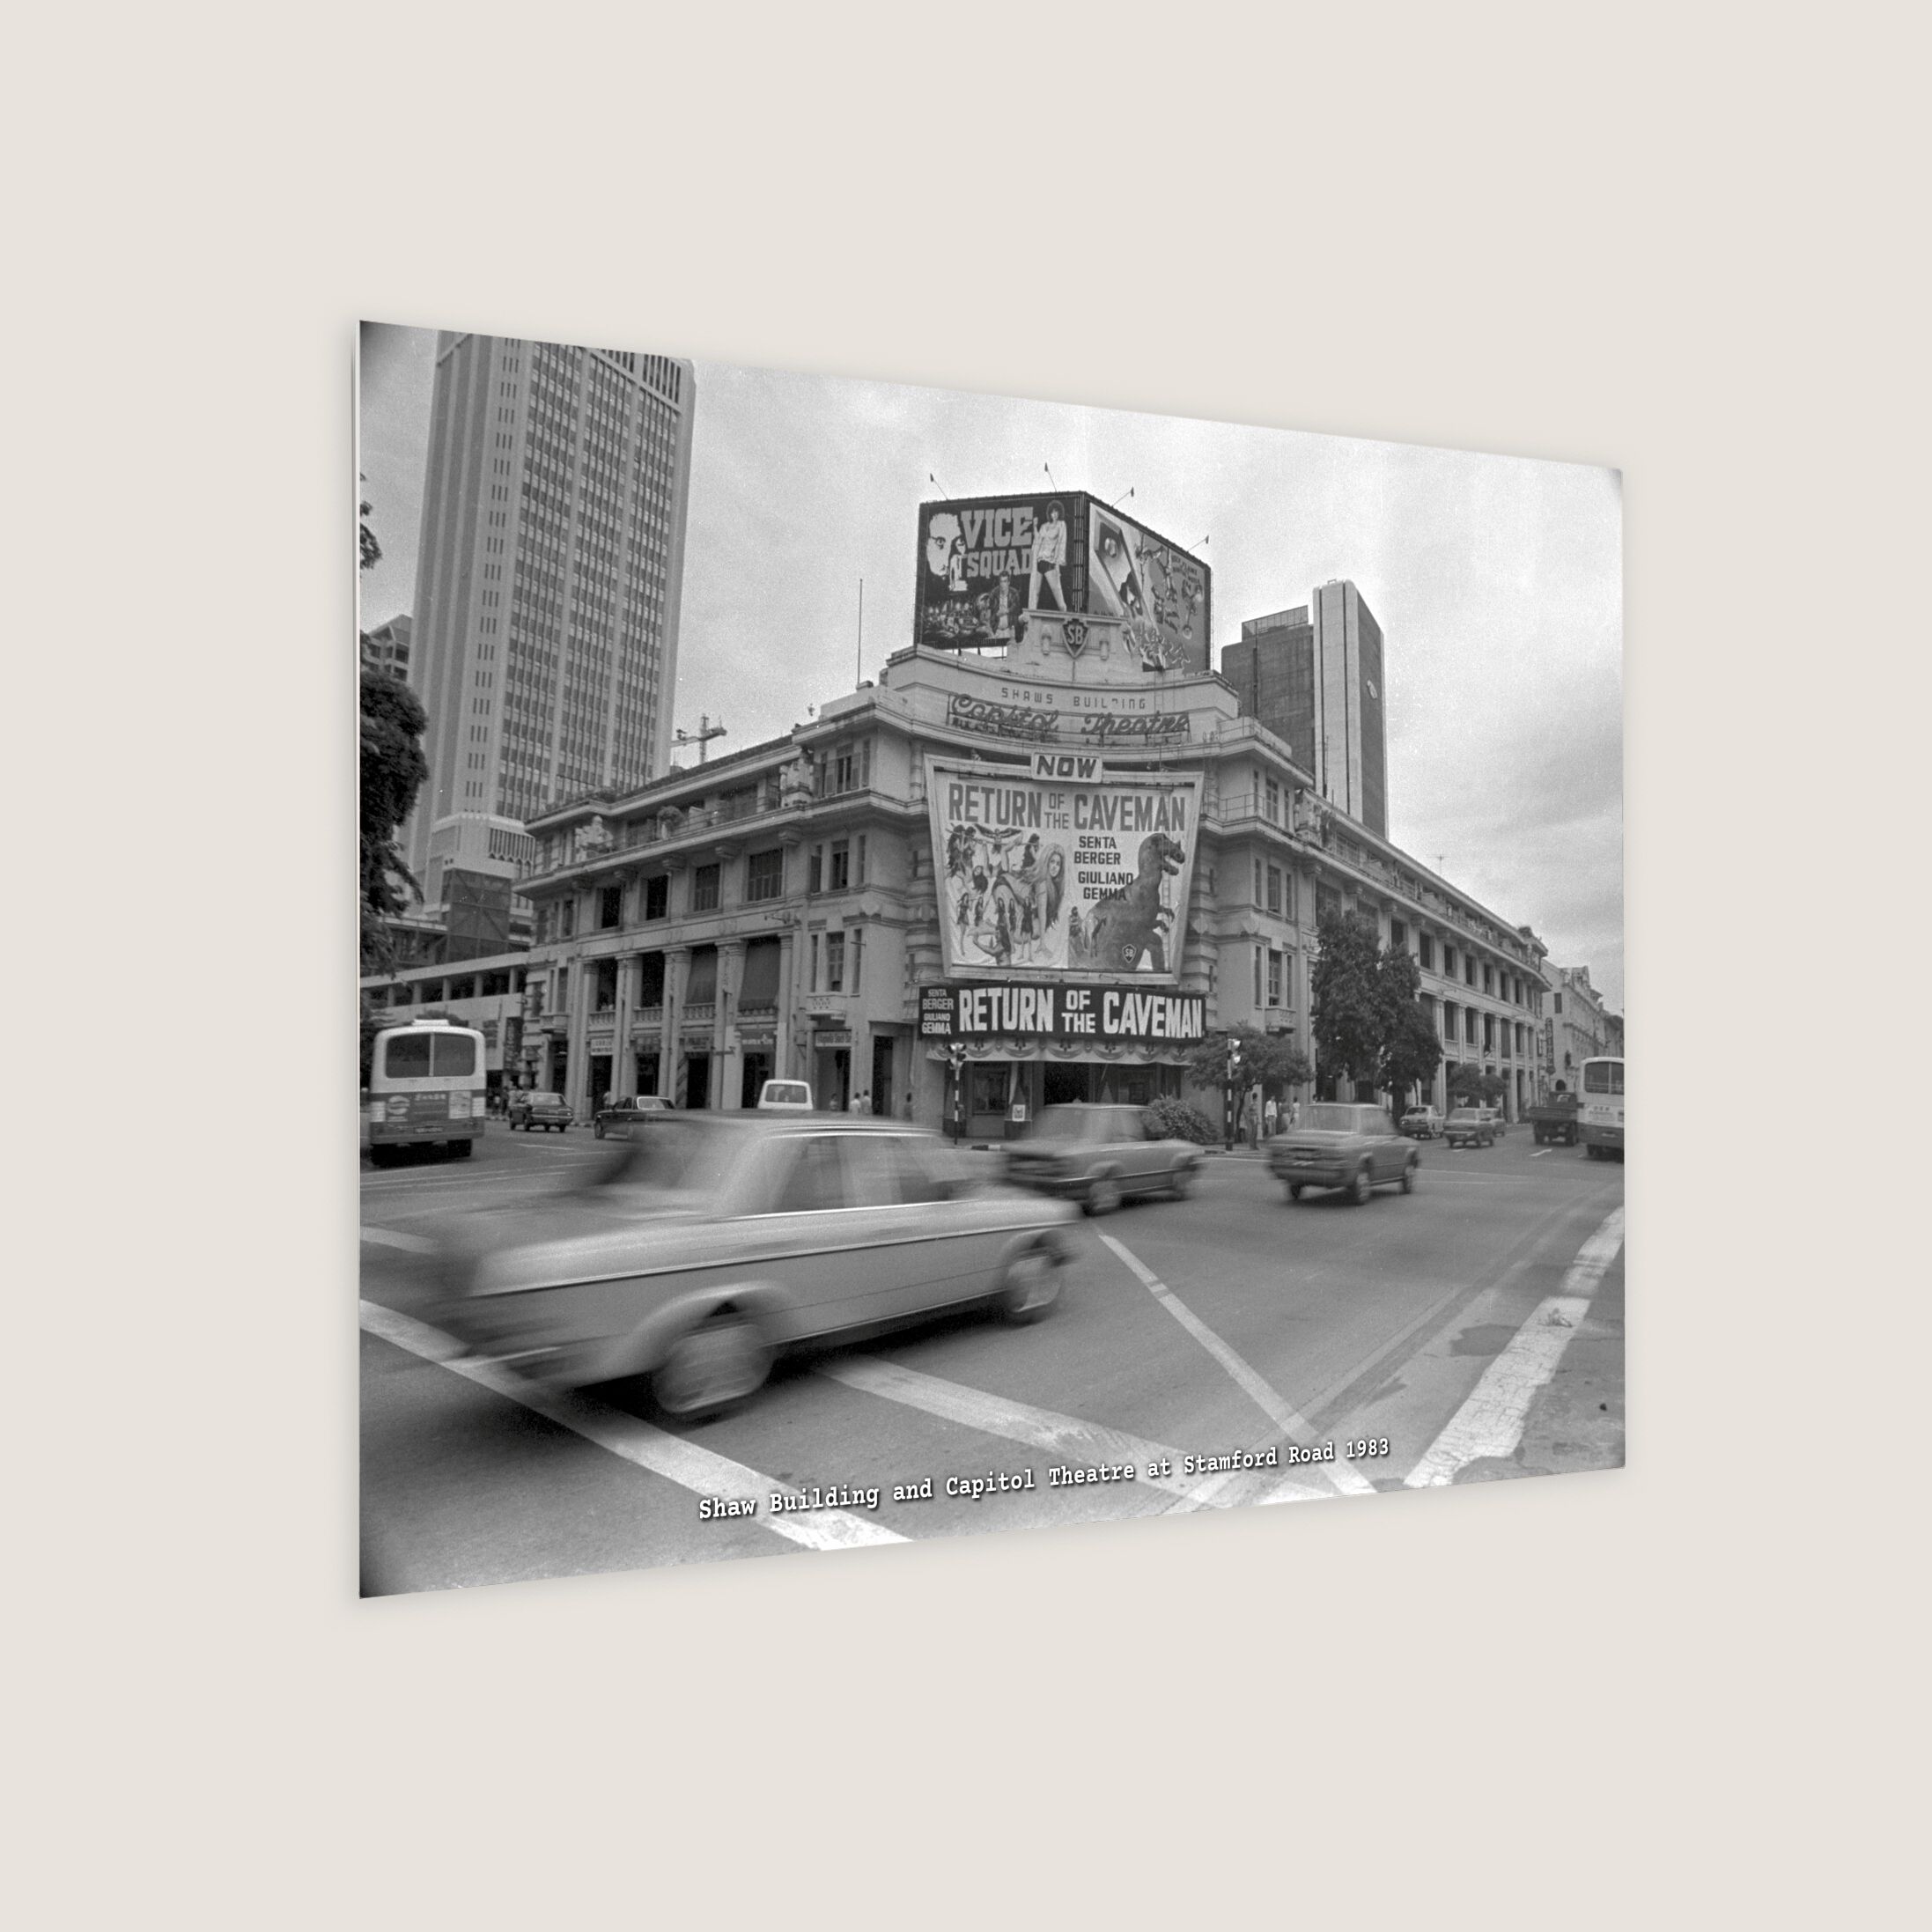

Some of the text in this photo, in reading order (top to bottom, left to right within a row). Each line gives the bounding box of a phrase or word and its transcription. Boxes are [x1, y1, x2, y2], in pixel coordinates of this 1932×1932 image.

[961, 506, 1034, 549] VICE
[967, 549, 1032, 578] SQUAD
[1067, 626, 1083, 645] SB
[1001, 687, 1053, 704] SHAWS
[952, 694, 1189, 735] Capitol Theatre
[1036, 755, 1096, 778] NOW
[948, 783, 1185, 831] RETURN OF THE CAVEMAN
[1079, 836, 1117, 850] SENTA
[1073, 852, 1121, 865] BERGER
[1078, 871, 1133, 886] GIULIANO
[1083, 887, 1126, 901] GEMMA
[923, 999, 954, 1010] BERGER
[959, 987, 1203, 1038] RETURN OF THE CAVEMAN
[922, 1022, 951, 1035] GEMMA
